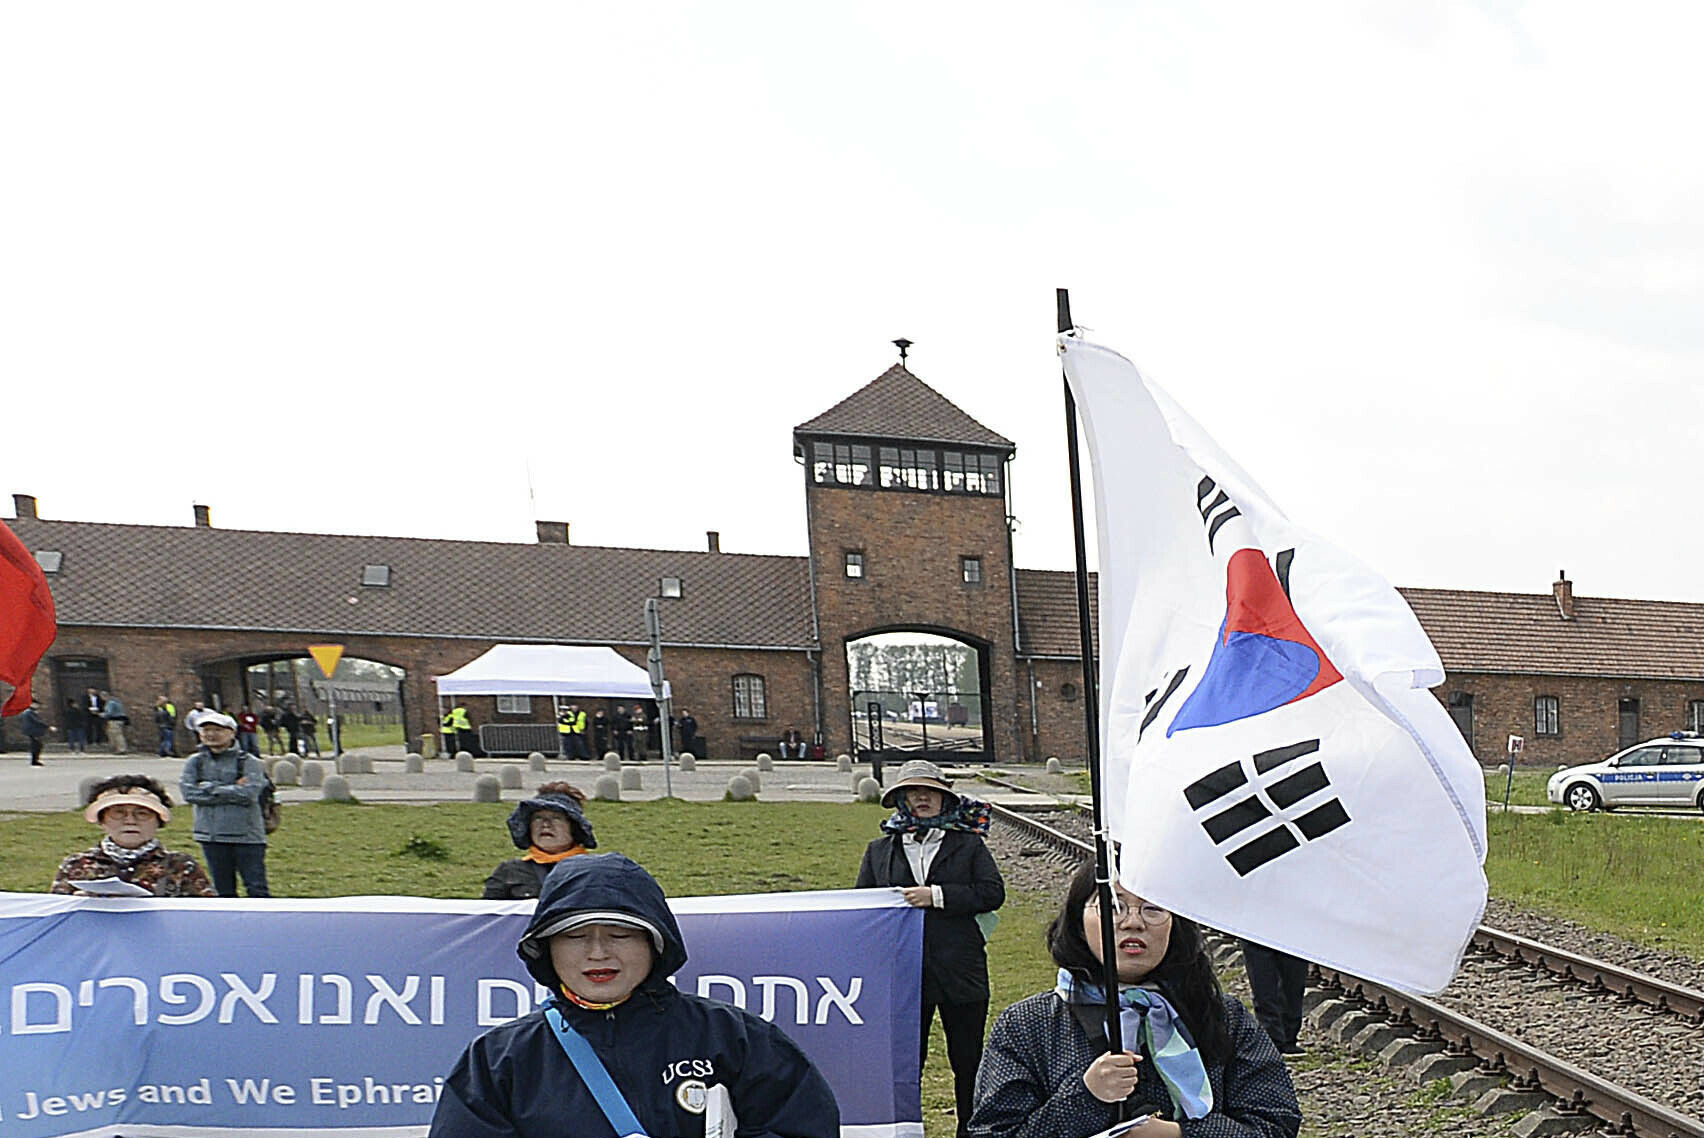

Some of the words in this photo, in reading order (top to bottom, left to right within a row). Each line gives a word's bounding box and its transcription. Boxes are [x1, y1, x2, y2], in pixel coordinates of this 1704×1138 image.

[11, 973, 280, 1036] אפרים
[16, 1087, 127, 1120] Jews
[138, 1077, 212, 1105] and
[225, 1077, 297, 1105] We
[309, 1076, 444, 1109] Ephrai
